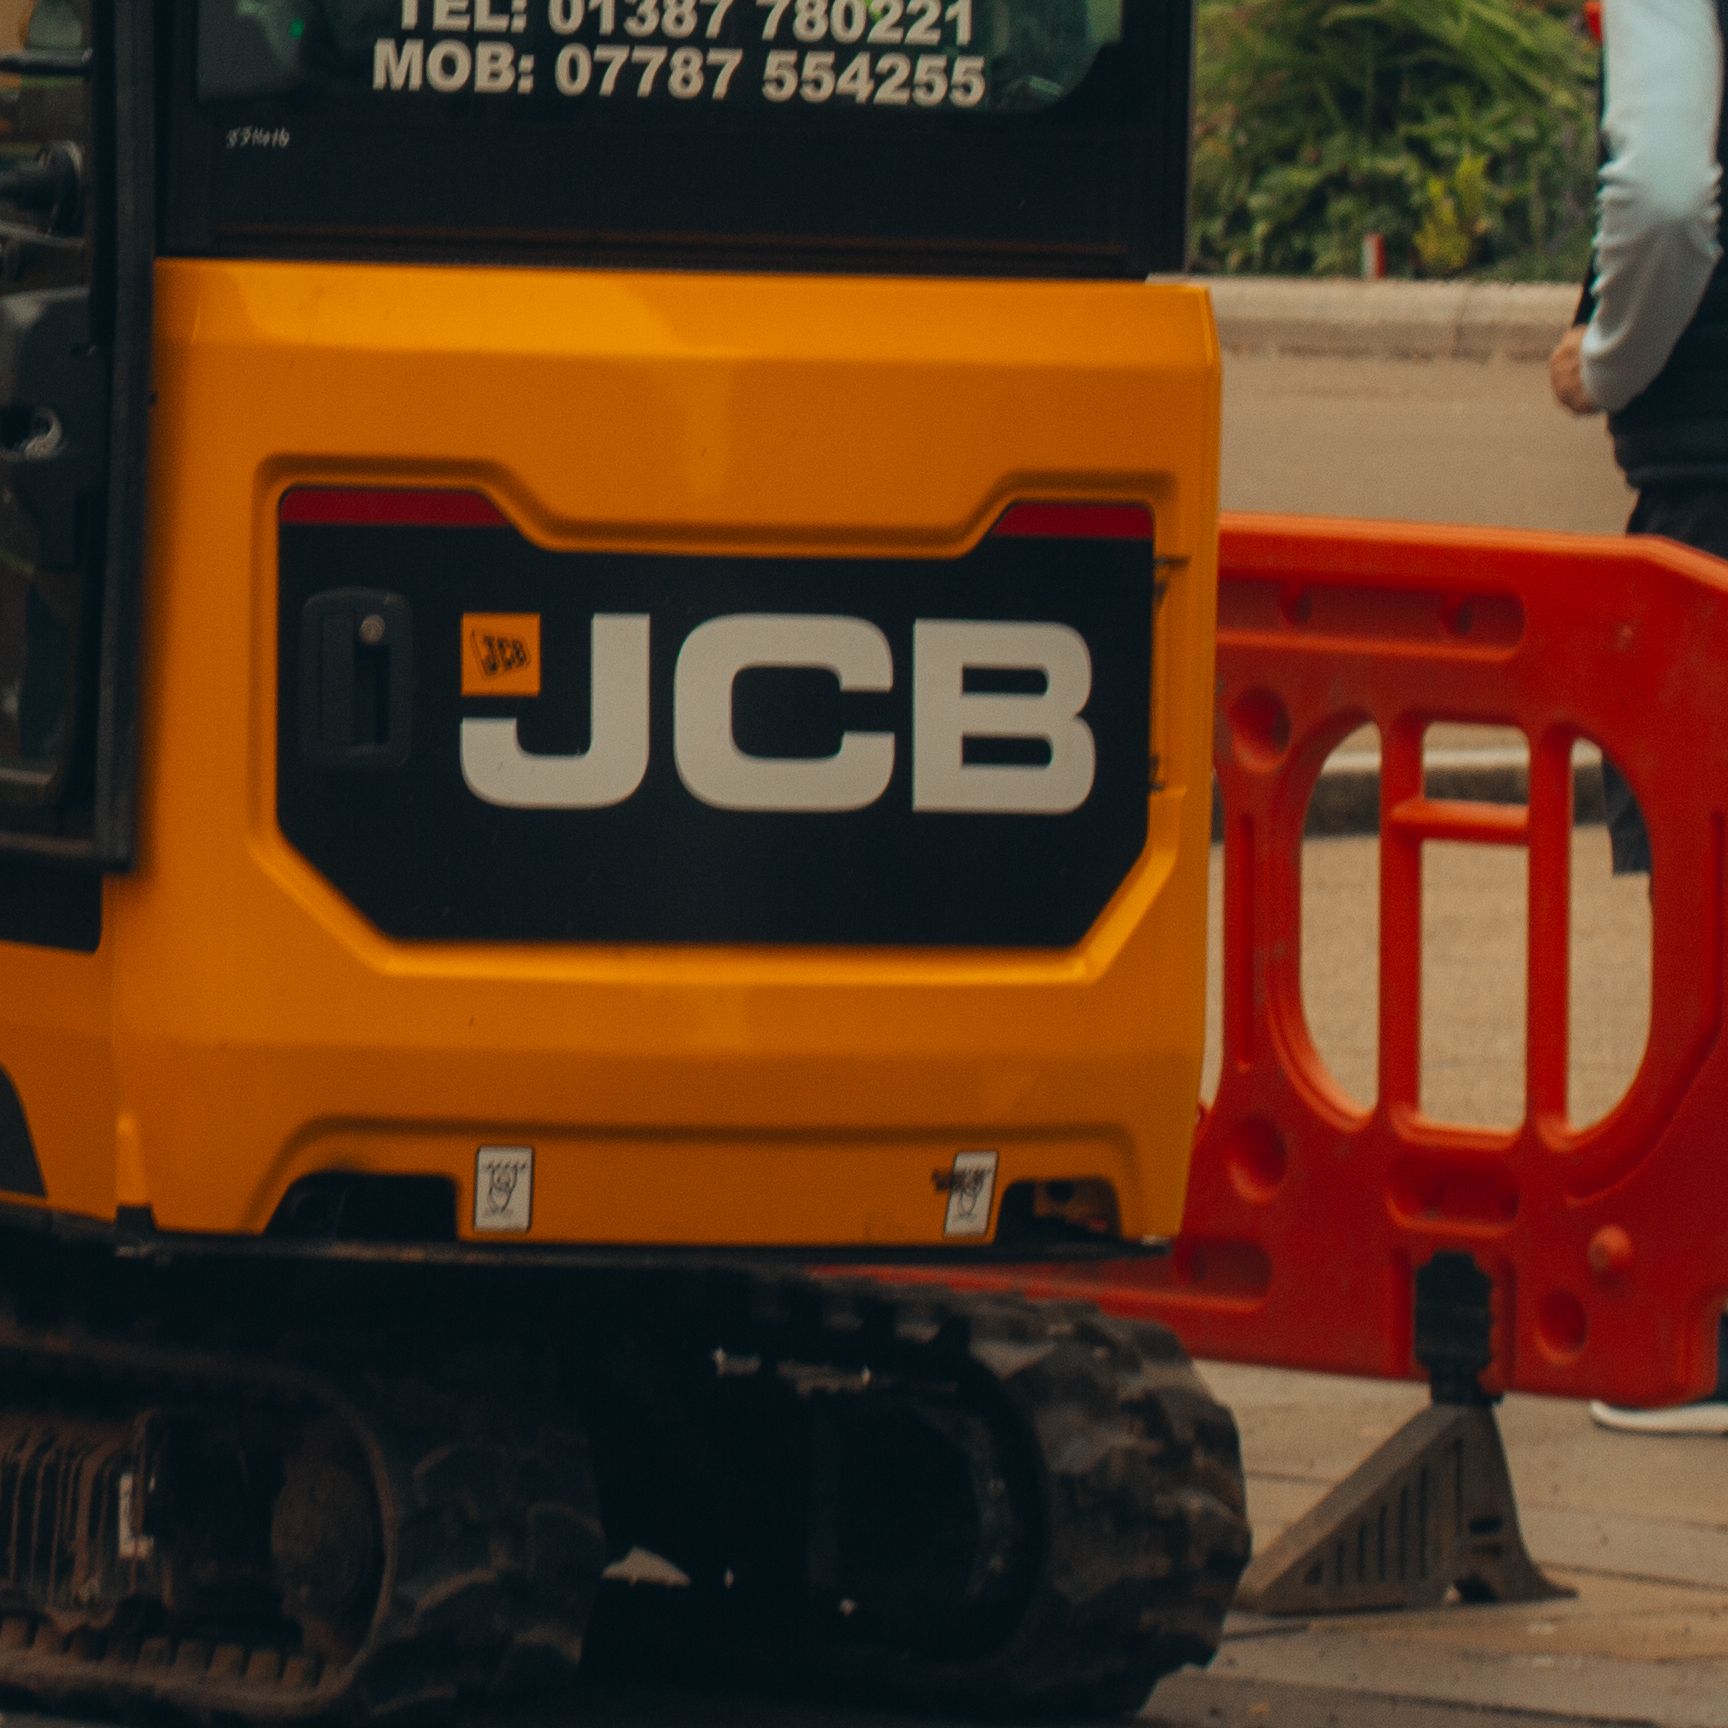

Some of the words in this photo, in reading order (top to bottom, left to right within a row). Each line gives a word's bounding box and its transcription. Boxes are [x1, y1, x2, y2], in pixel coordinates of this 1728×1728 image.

[372, 38, 536, 95] MOB:
[555, 43, 744, 100] 07787
[761, 49, 986, 107] 554255
[481, 634, 529, 677] JCB
[460, 613, 1096, 814] JCB
